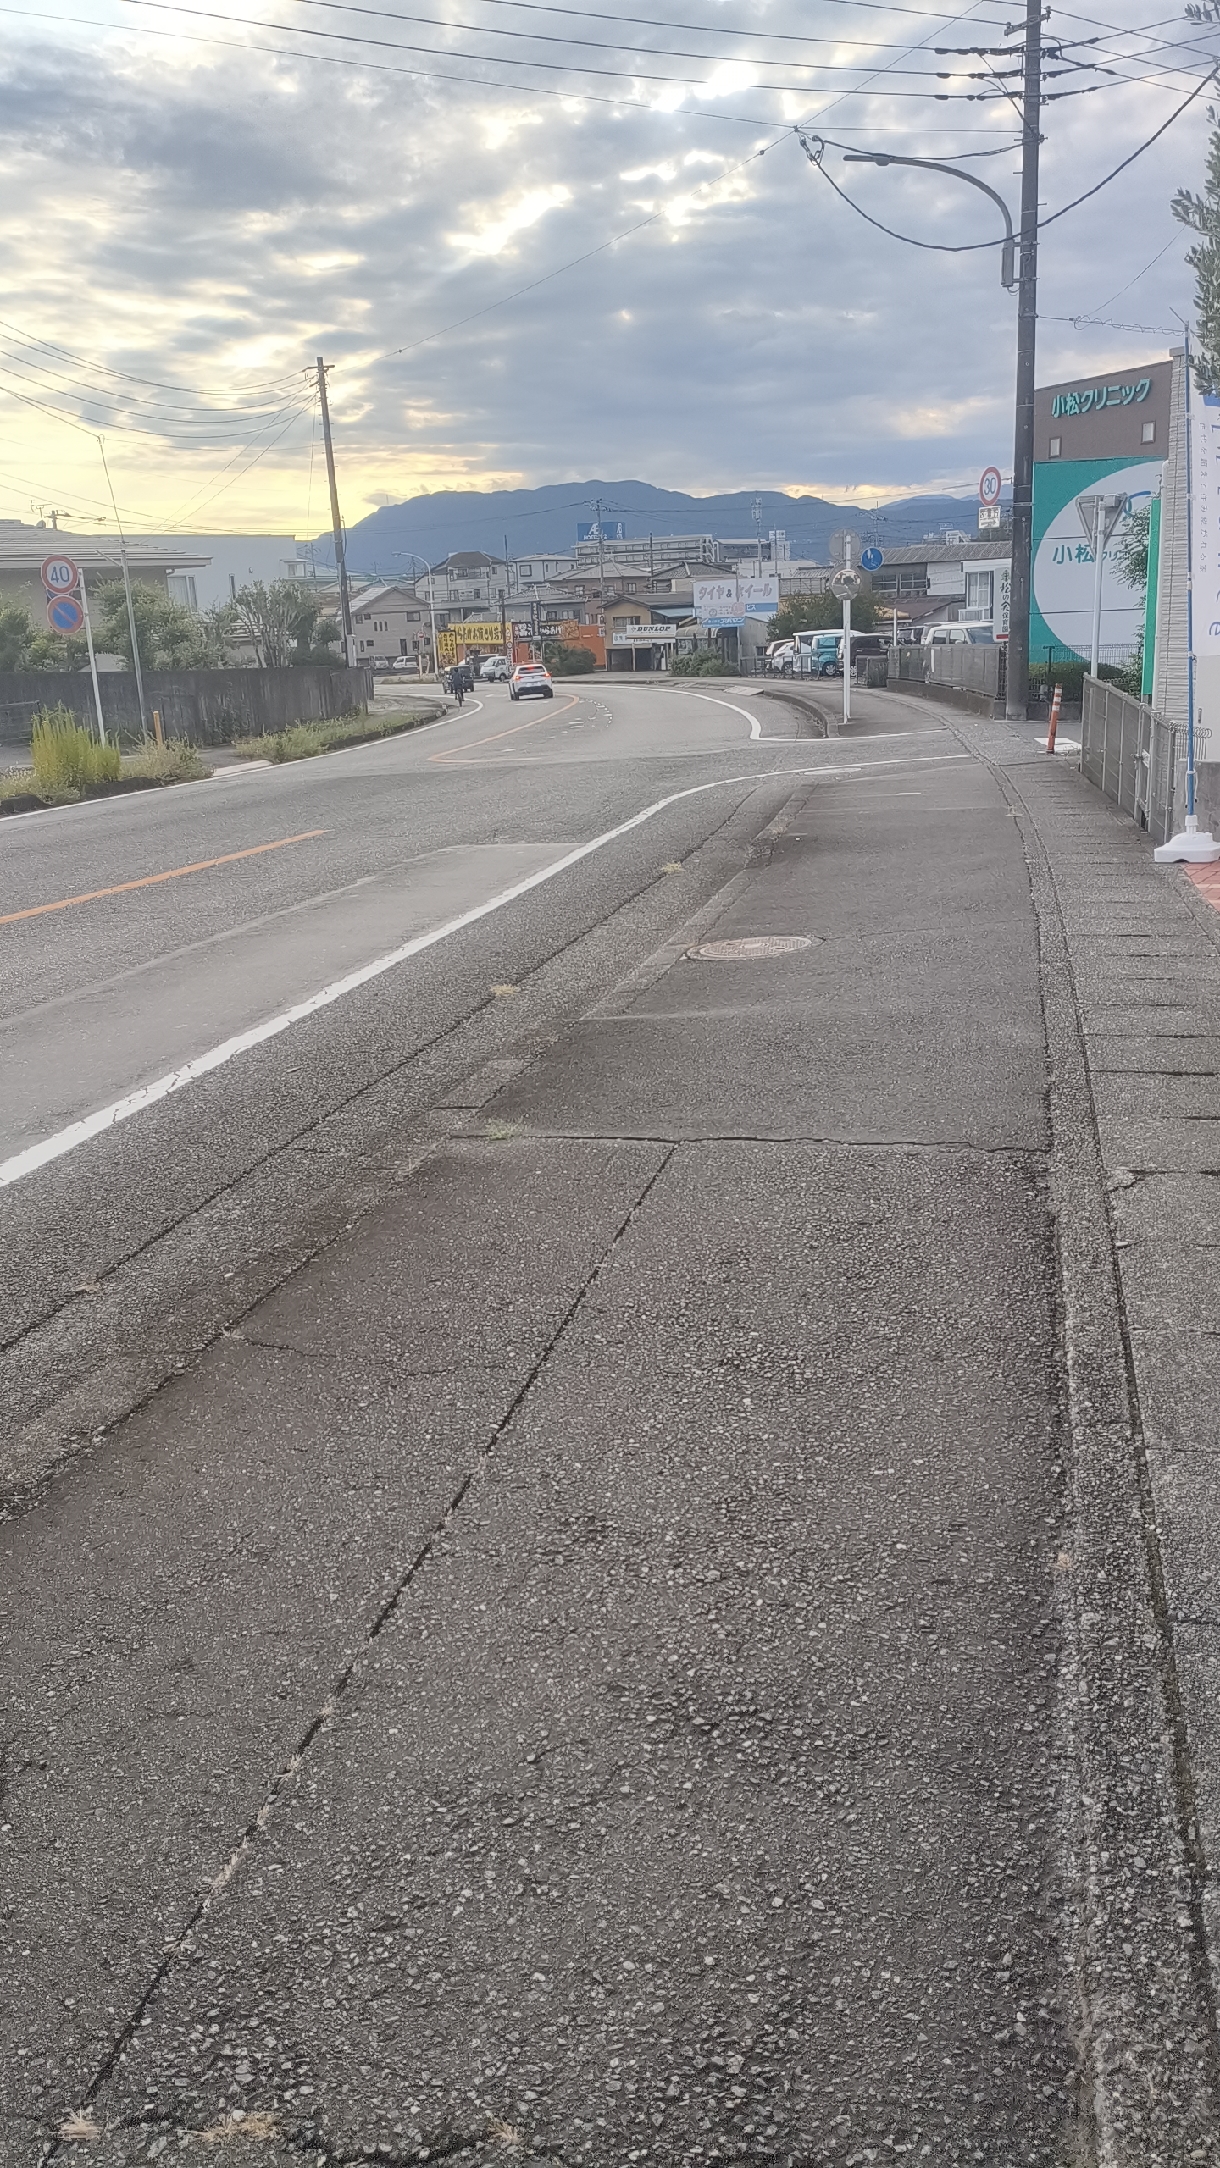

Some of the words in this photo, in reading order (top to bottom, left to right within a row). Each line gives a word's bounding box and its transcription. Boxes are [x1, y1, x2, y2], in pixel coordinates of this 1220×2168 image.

[1052, 379, 1150, 418] 小松クリニック
[984, 477, 997, 495] 30
[51, 566, 70, 583] 40
